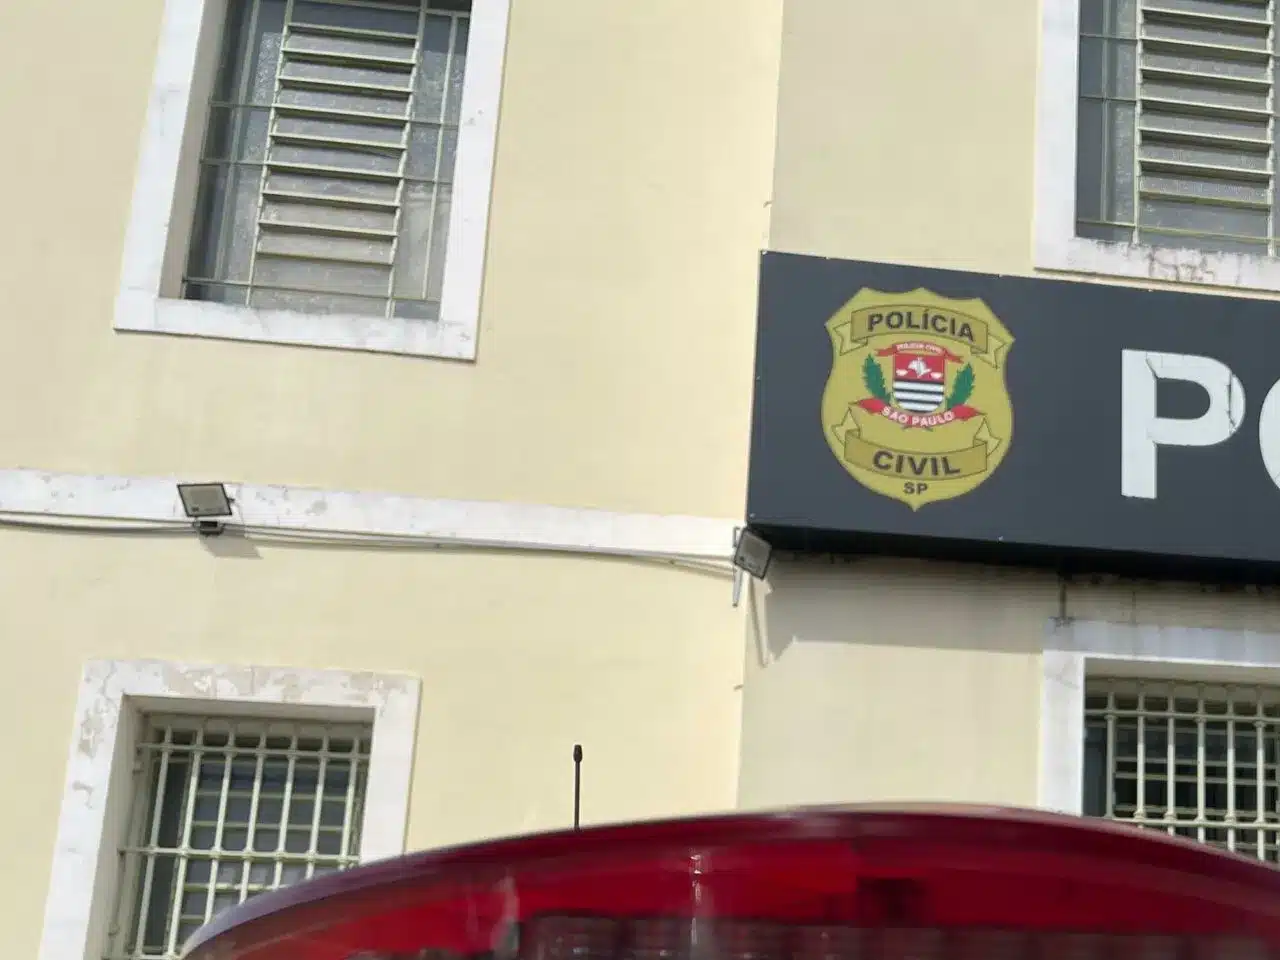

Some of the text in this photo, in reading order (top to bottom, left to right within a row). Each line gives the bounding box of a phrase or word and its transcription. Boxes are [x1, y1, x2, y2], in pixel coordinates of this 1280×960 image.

[867, 309, 975, 342] POLÍCIA
[911, 410, 956, 427] PAULO
[873, 450, 961, 476] CIVIL
[904, 481, 928, 495] SP
